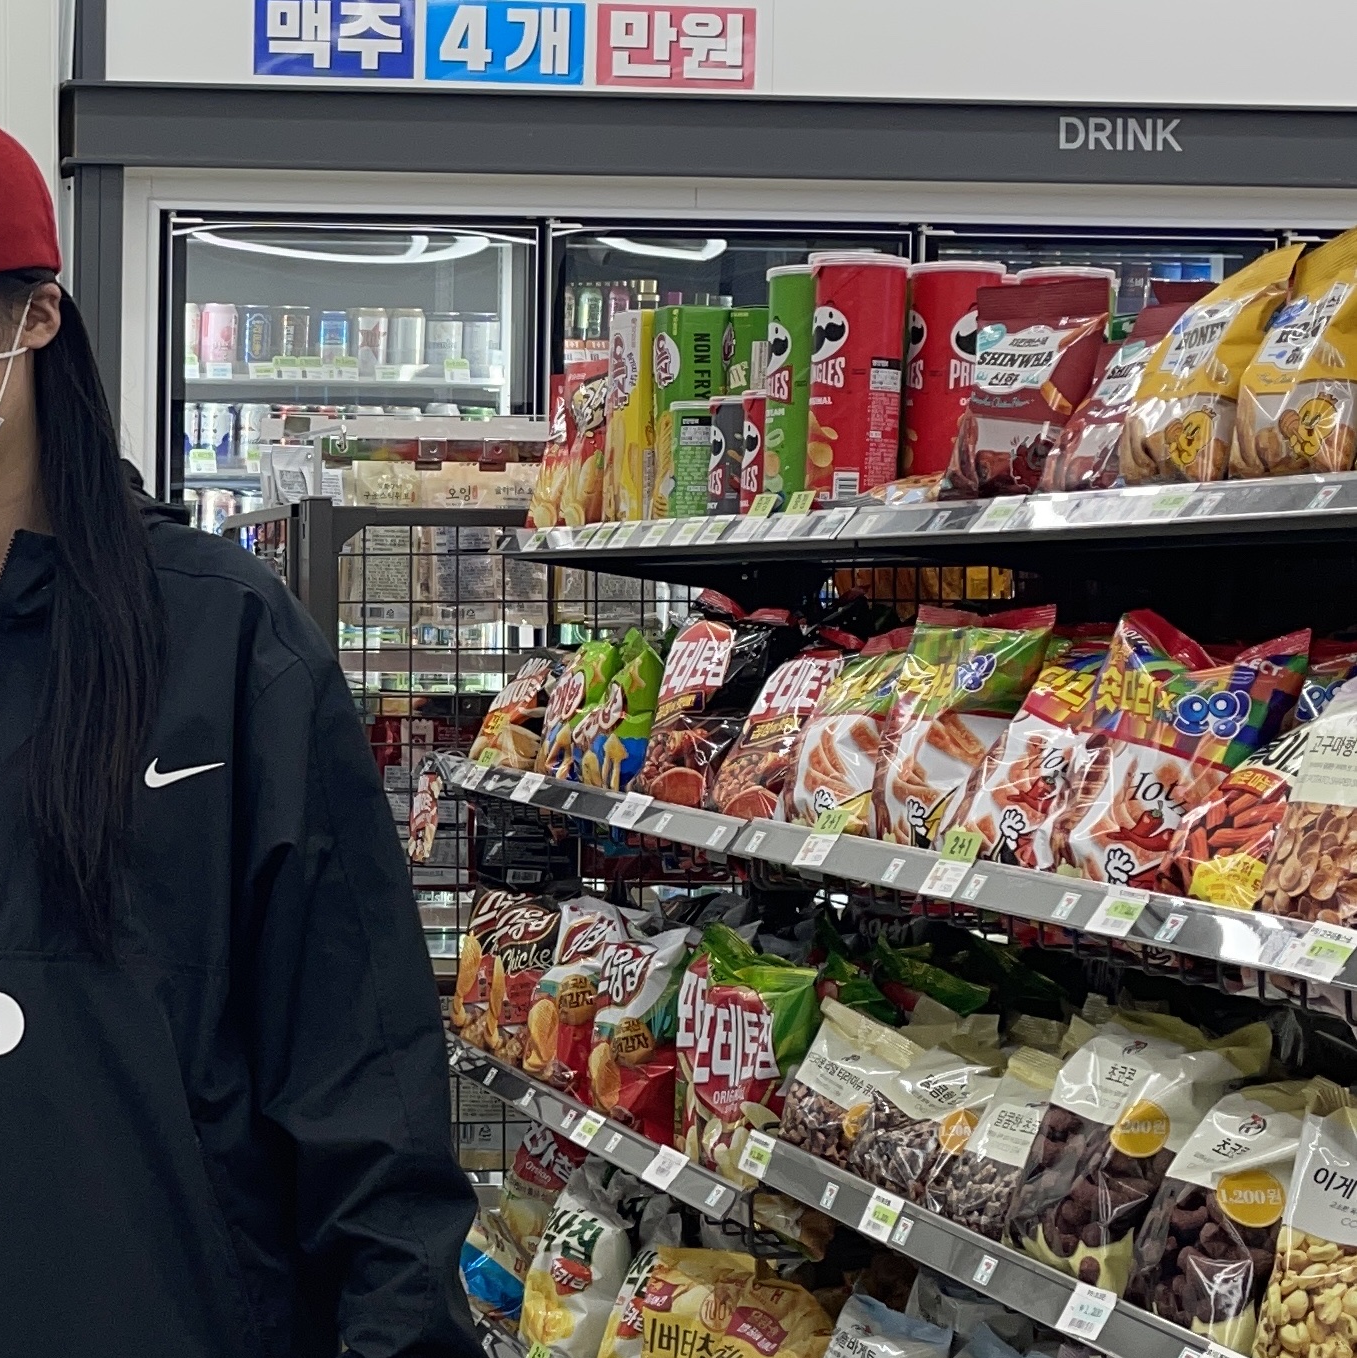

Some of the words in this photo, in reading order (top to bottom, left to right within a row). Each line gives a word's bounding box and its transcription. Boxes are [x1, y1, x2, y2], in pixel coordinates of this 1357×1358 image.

[267, 0, 403, 70] 맥주
[439, 4, 570, 76] 4개
[609, 10, 745, 80] 만원
[1059, 116, 1183, 151] DRINK
[693, 333, 711, 363] NON
[977, 350, 1055, 368] SHINWHA
[693, 369, 711, 400] FRY
[988, 371, 1020, 386] 신화
[445, 485, 471, 502] 오잉
[820, 813, 842, 830] 2+1
[948, 836, 973, 857] 2+1
